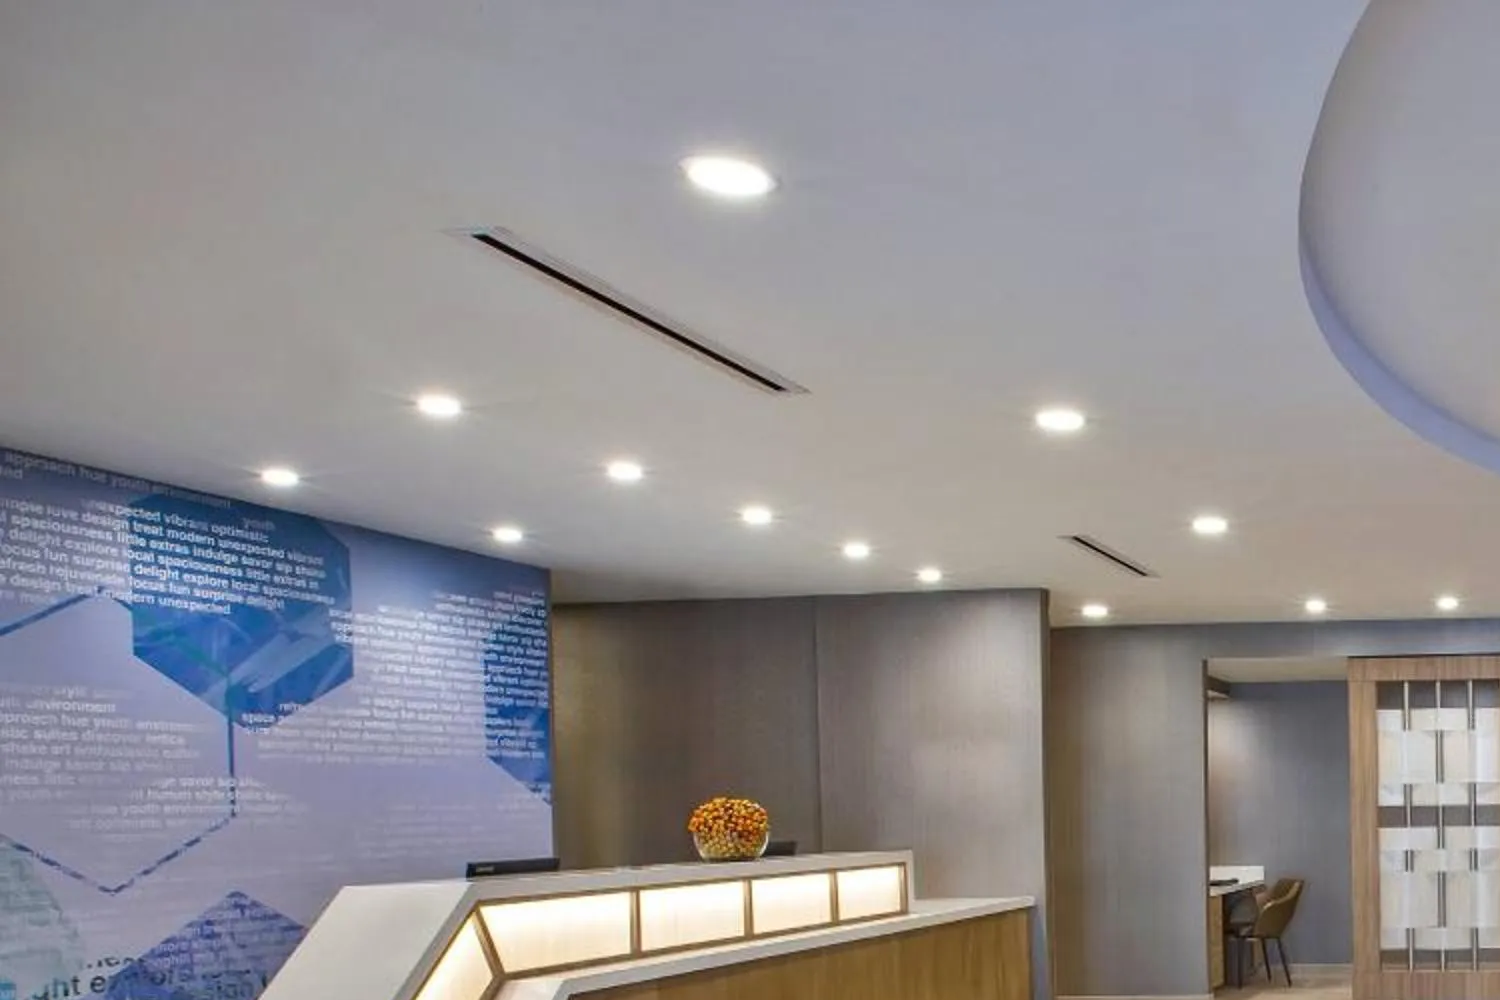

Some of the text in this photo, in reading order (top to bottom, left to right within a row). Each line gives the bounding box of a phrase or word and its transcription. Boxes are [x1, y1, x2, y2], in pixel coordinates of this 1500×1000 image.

[11, 514, 114, 541] spaciousness
[166, 526, 215, 546] modern
[218, 538, 285, 560] unexpected
[133, 562, 180, 581] delight
[182, 571, 229, 590] explore
